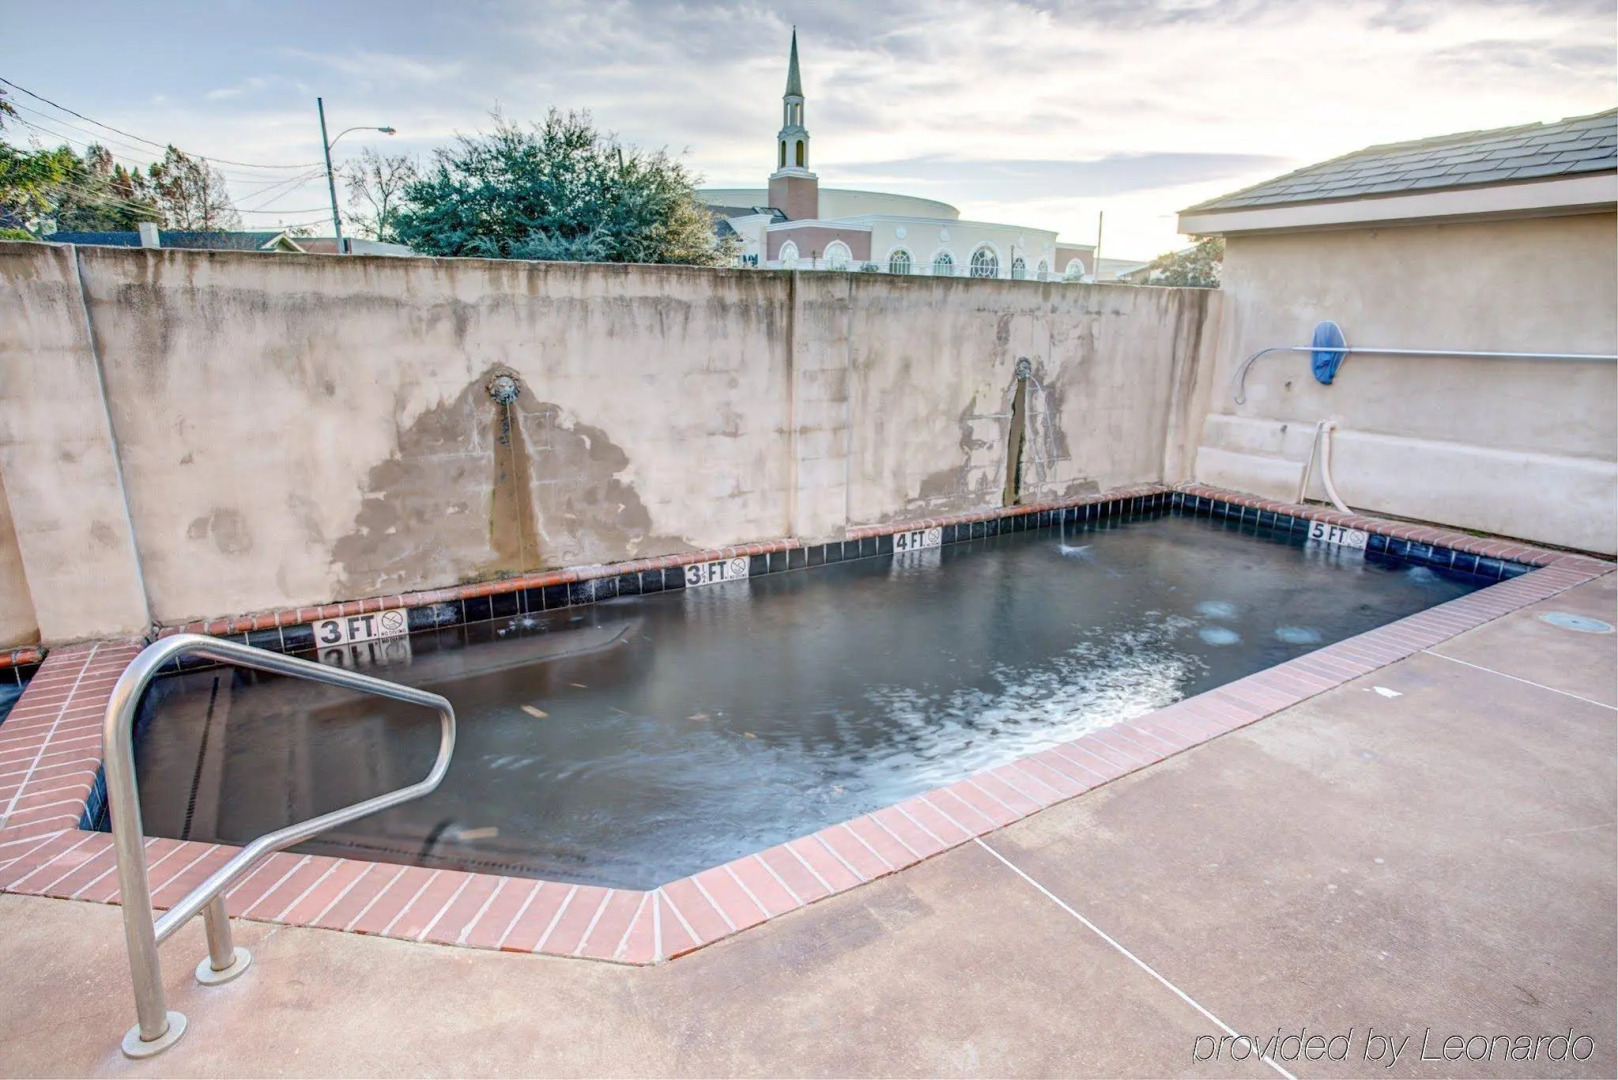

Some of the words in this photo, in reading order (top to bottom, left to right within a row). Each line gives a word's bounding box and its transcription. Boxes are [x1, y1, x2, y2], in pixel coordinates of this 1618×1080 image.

[1312, 523, 1324, 538] 5
[897, 534, 907, 550] 4
[708, 561, 727, 581] FT.
[321, 620, 342, 644] 3
[347, 615, 377, 640] FT.
